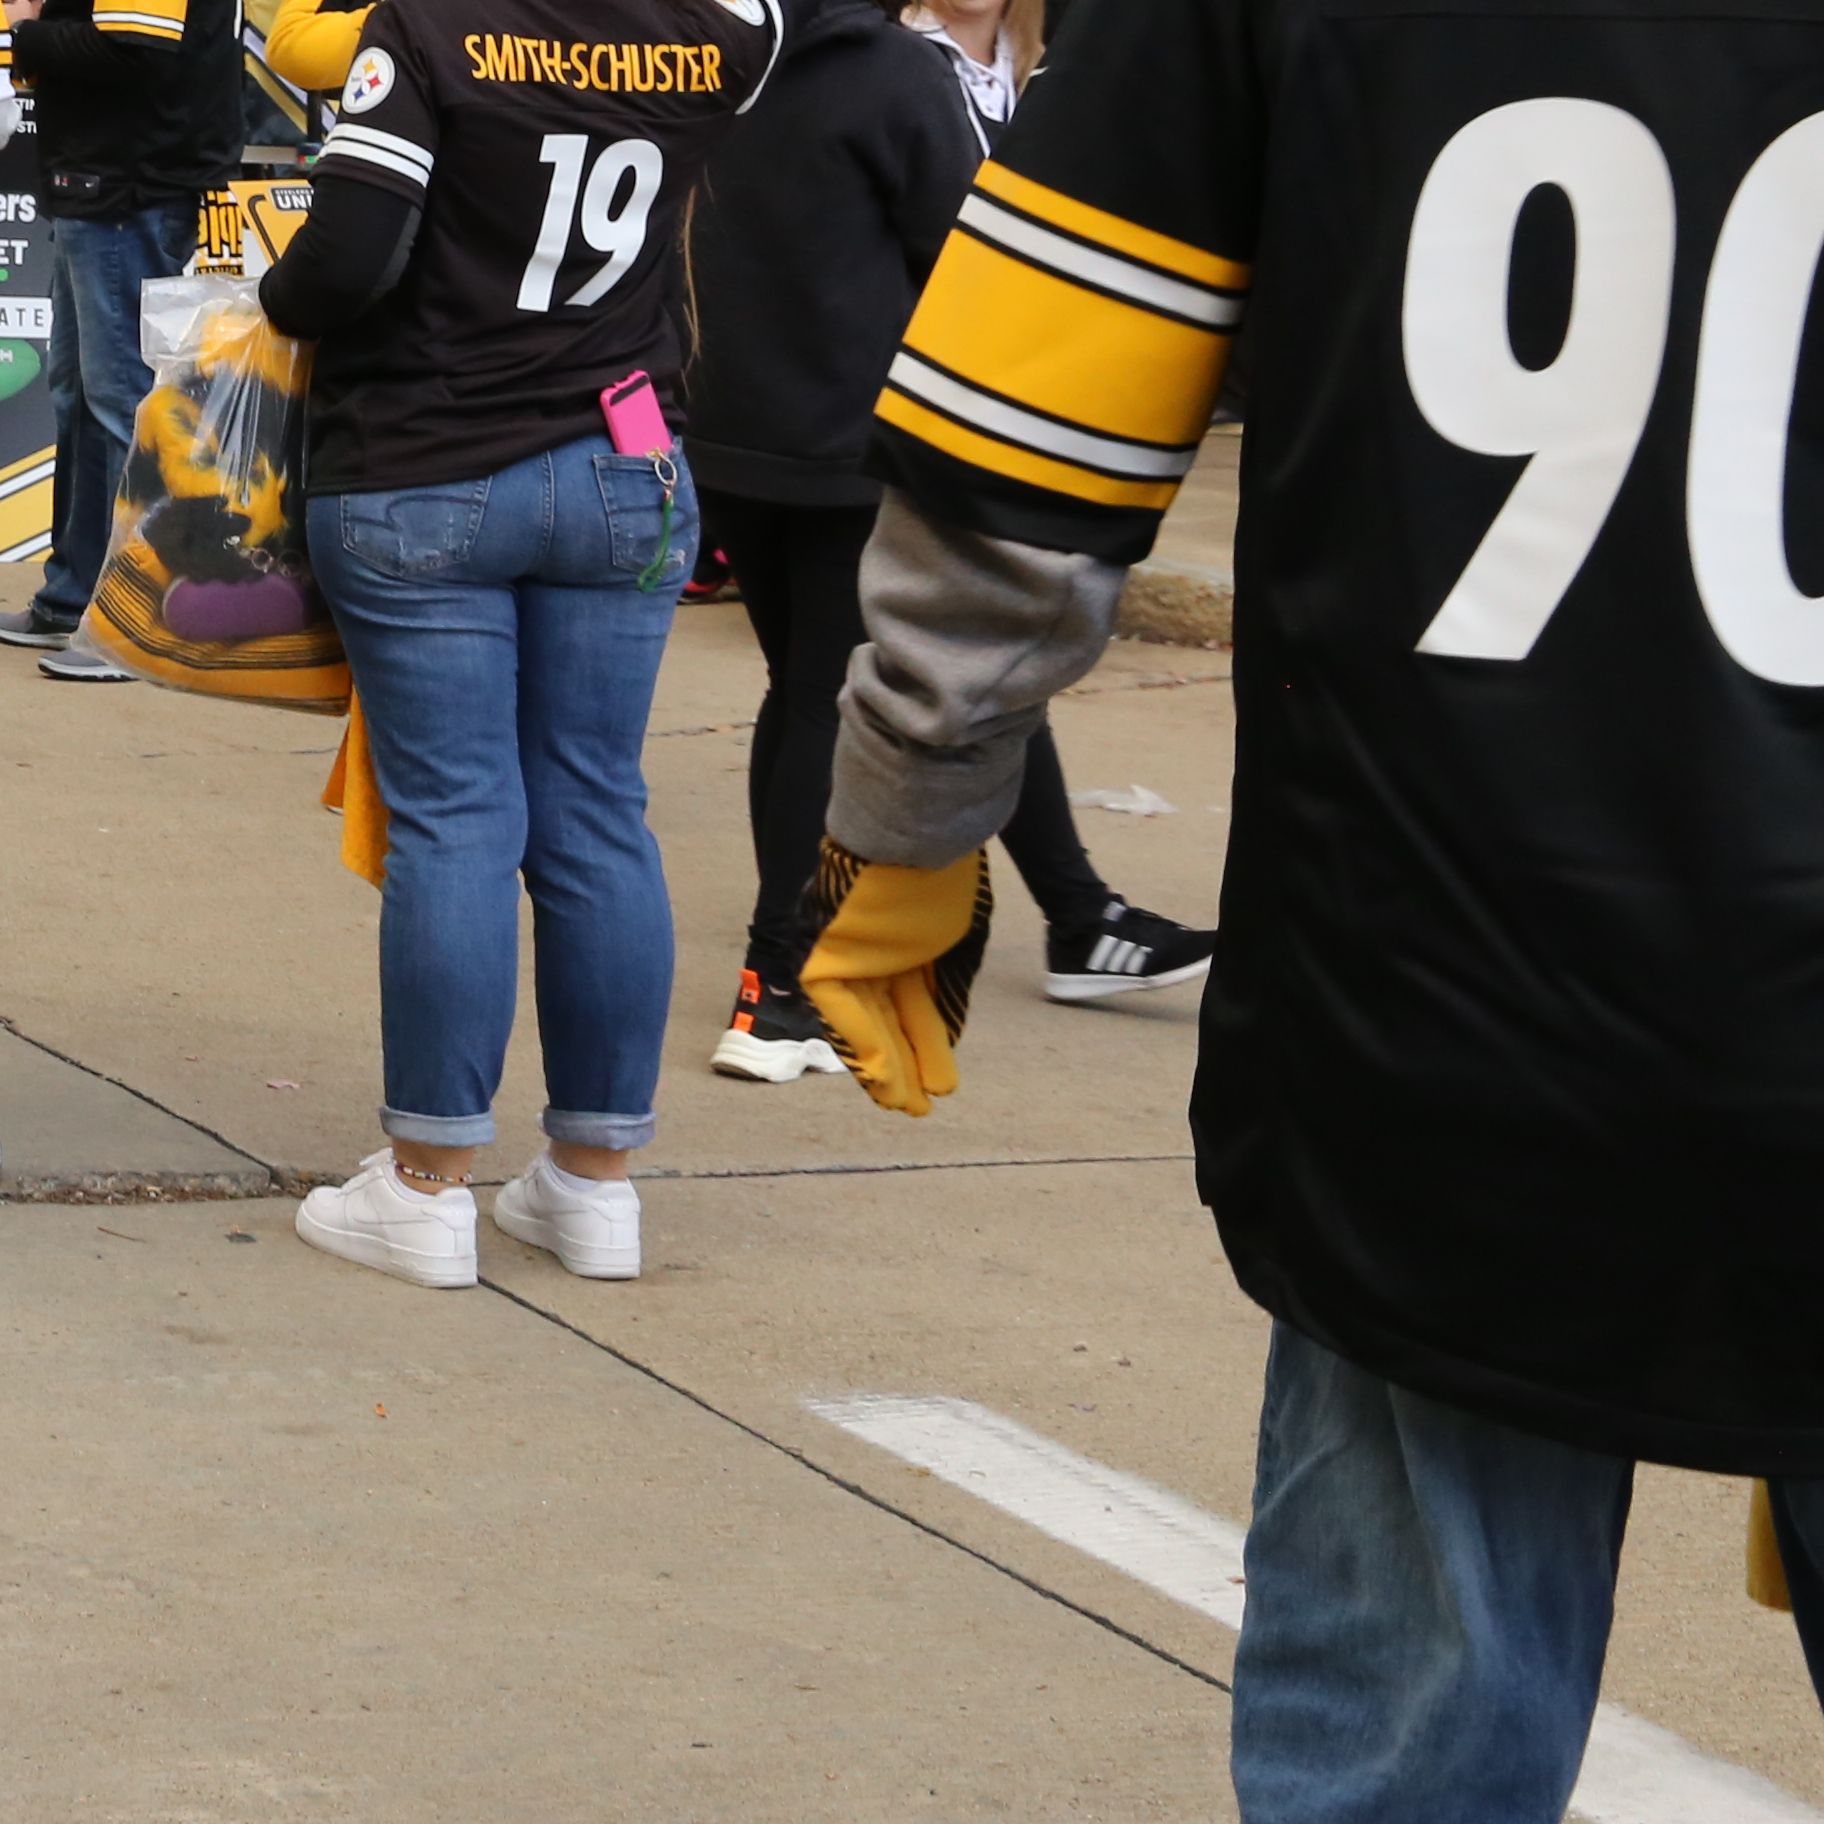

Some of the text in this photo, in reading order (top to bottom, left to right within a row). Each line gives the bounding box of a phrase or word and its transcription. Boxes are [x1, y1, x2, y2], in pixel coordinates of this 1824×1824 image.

[464, 33, 722, 93] SMITH-SCHUSTER
[276, 194, 312, 209] UNI
[516, 134, 664, 313] 19
